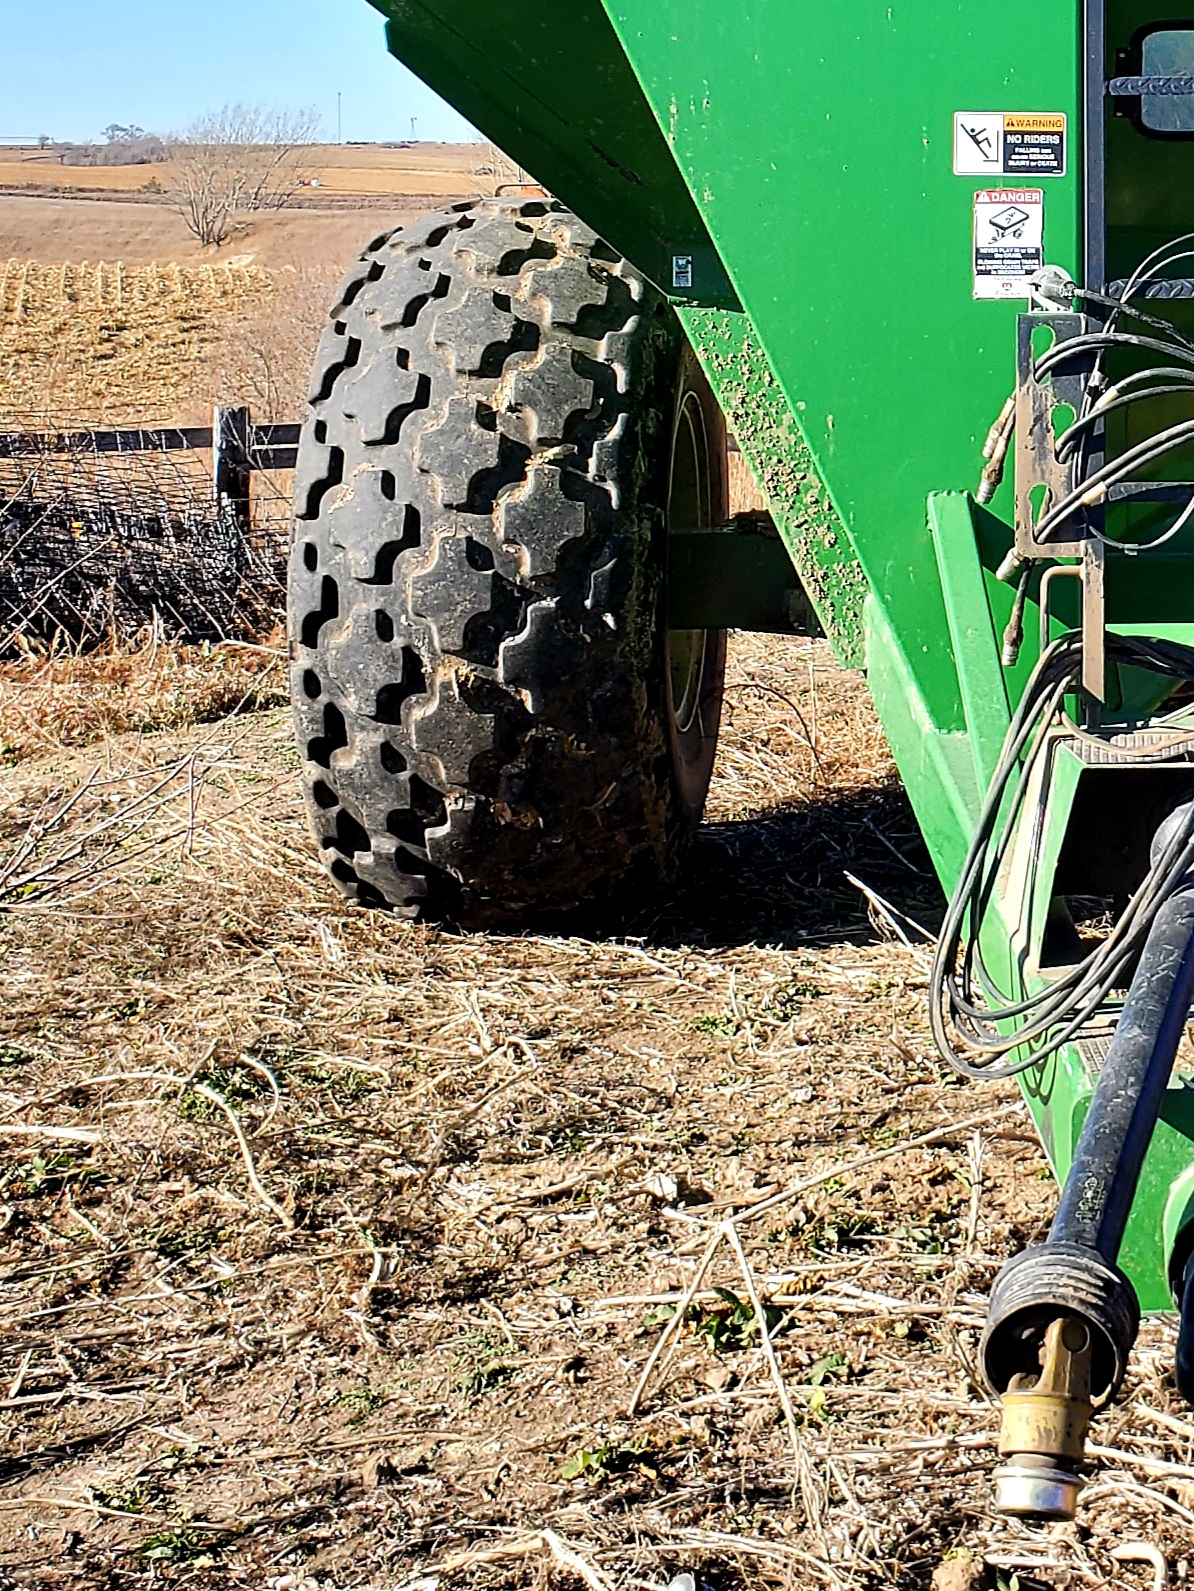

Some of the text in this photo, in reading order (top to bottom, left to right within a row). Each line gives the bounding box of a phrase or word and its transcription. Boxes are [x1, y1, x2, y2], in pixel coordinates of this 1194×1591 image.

[1016, 119, 1062, 128] WARNING
[1006, 134, 1060, 145] NO RIDERS
[991, 192, 1040, 202] DANGER
